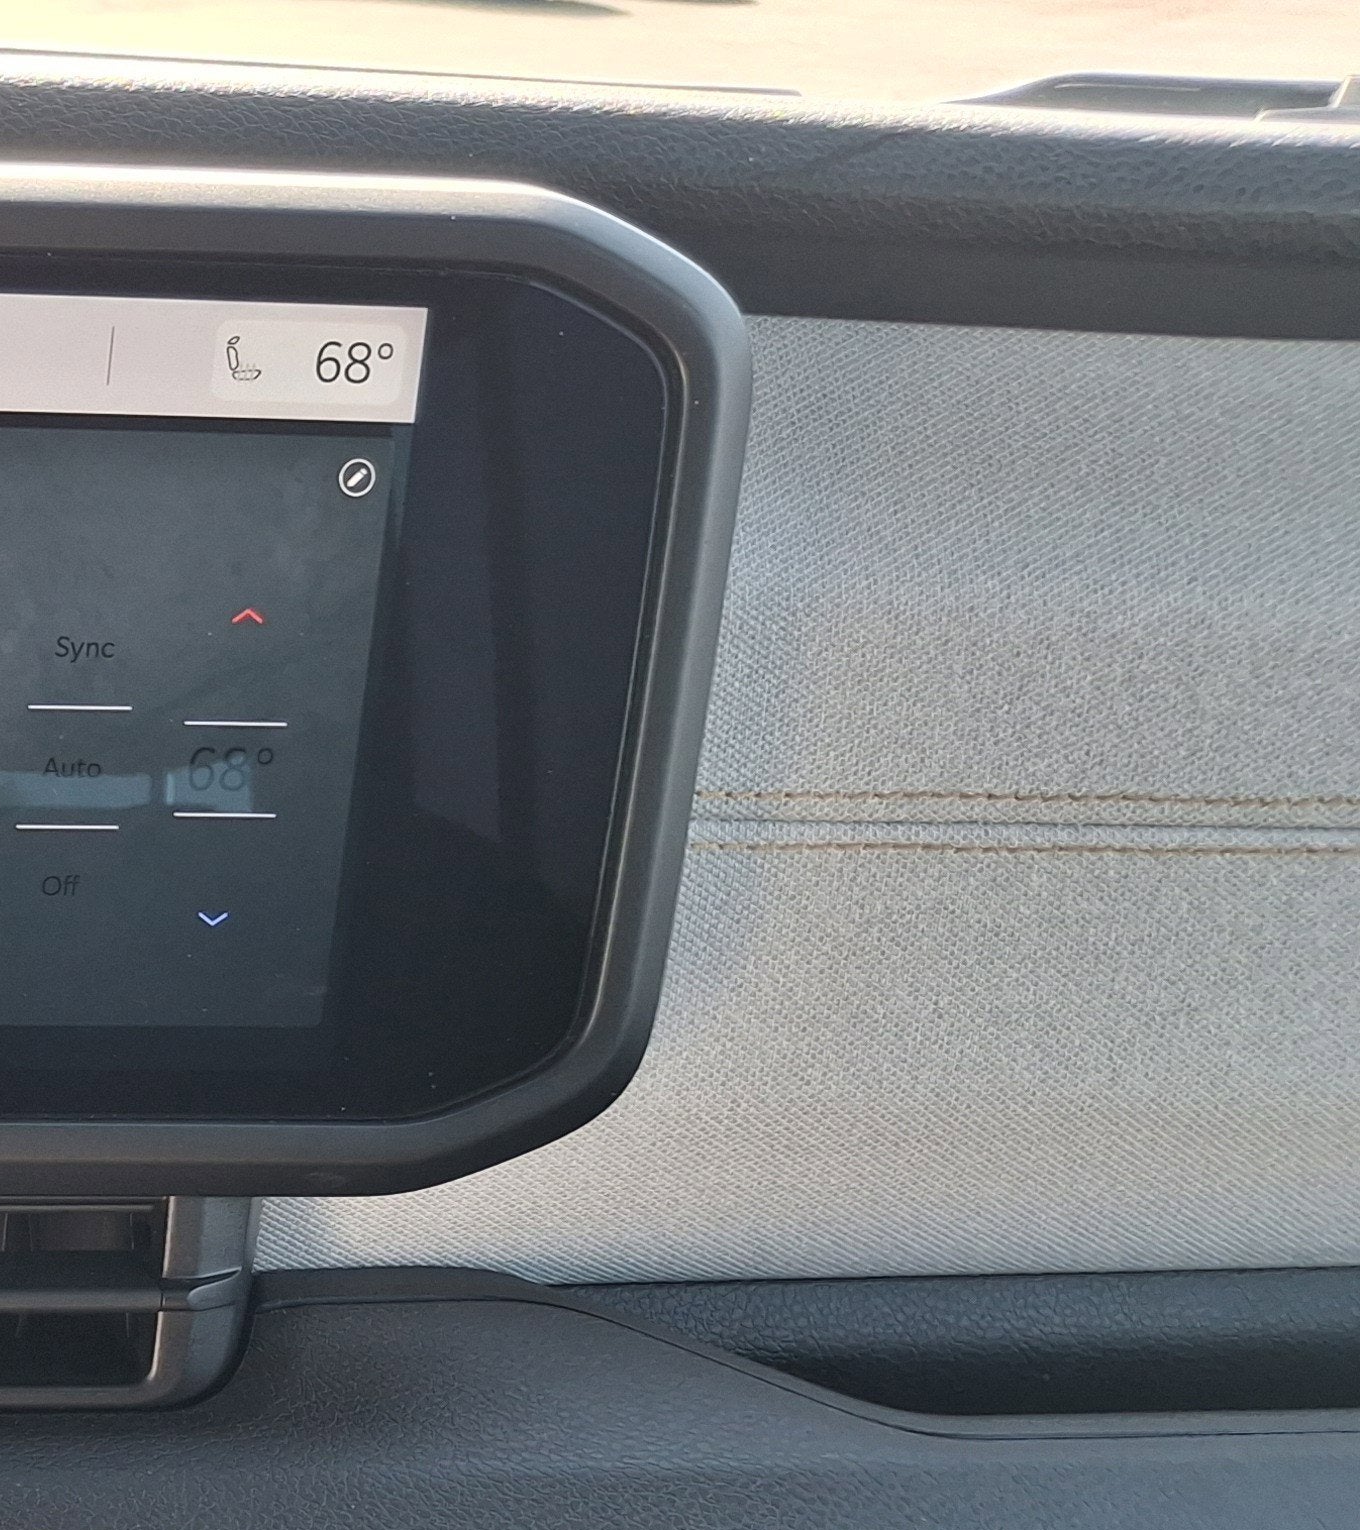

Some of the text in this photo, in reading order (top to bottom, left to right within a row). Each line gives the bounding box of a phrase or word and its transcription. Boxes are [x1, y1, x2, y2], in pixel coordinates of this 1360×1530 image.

[313, 338, 395, 387] 68°
[54, 635, 116, 663] Sync
[42, 756, 103, 779] Auto
[41, 874, 82, 897] Off
